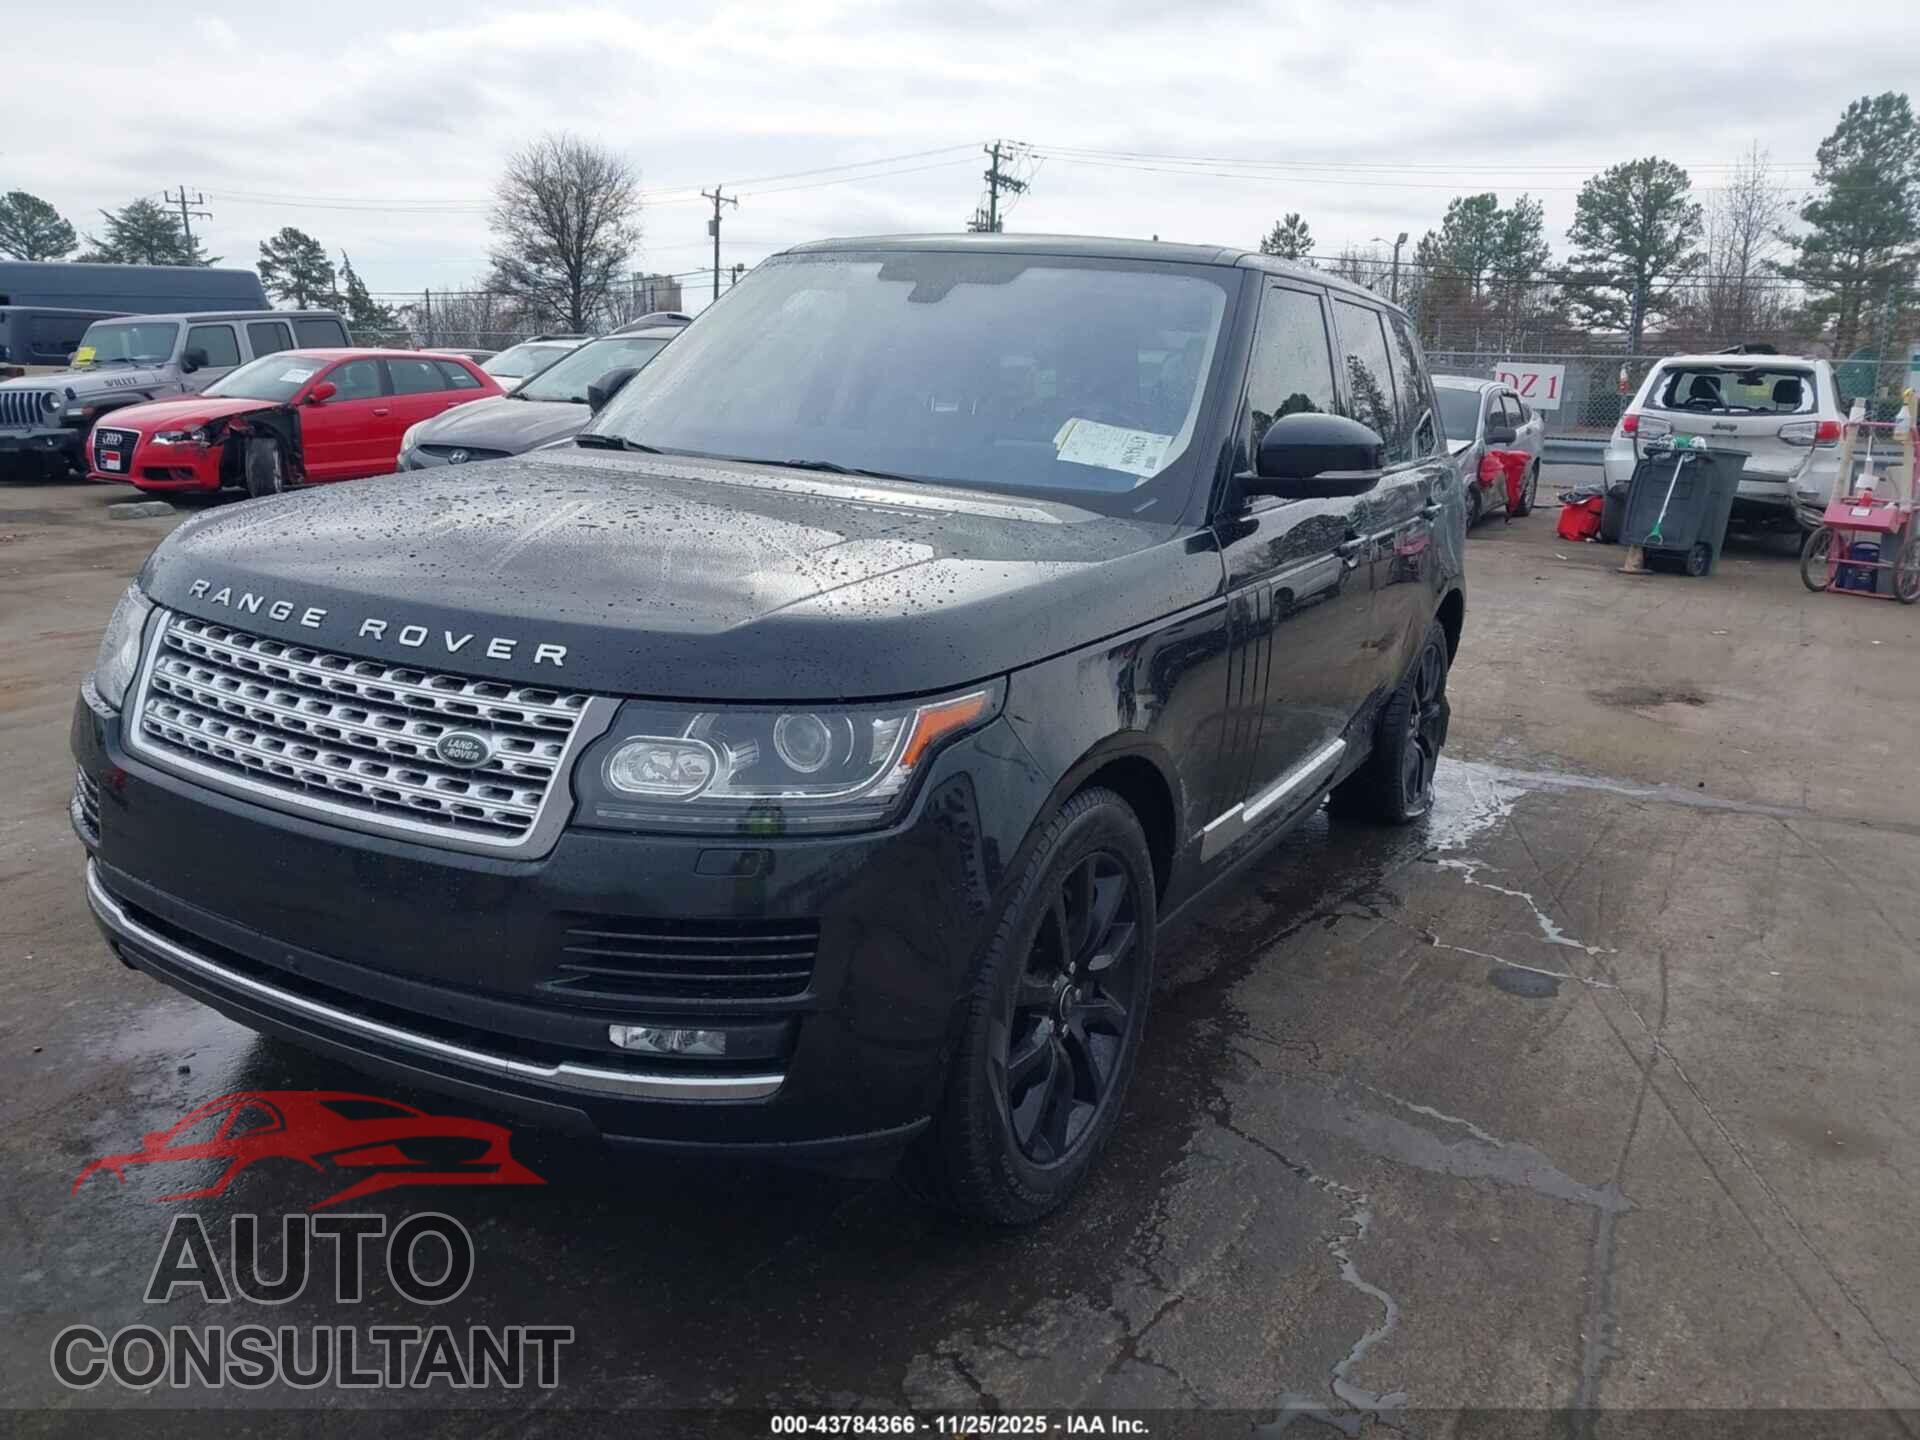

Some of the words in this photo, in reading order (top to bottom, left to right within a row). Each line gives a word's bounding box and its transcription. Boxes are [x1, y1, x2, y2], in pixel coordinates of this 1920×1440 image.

[1547, 375, 1557, 399] 1
[189, 578, 328, 629] RANGE
[359, 618, 568, 667] ROVER
[447, 739, 473, 750] LAND
[447, 748, 480, 760] ROVER
